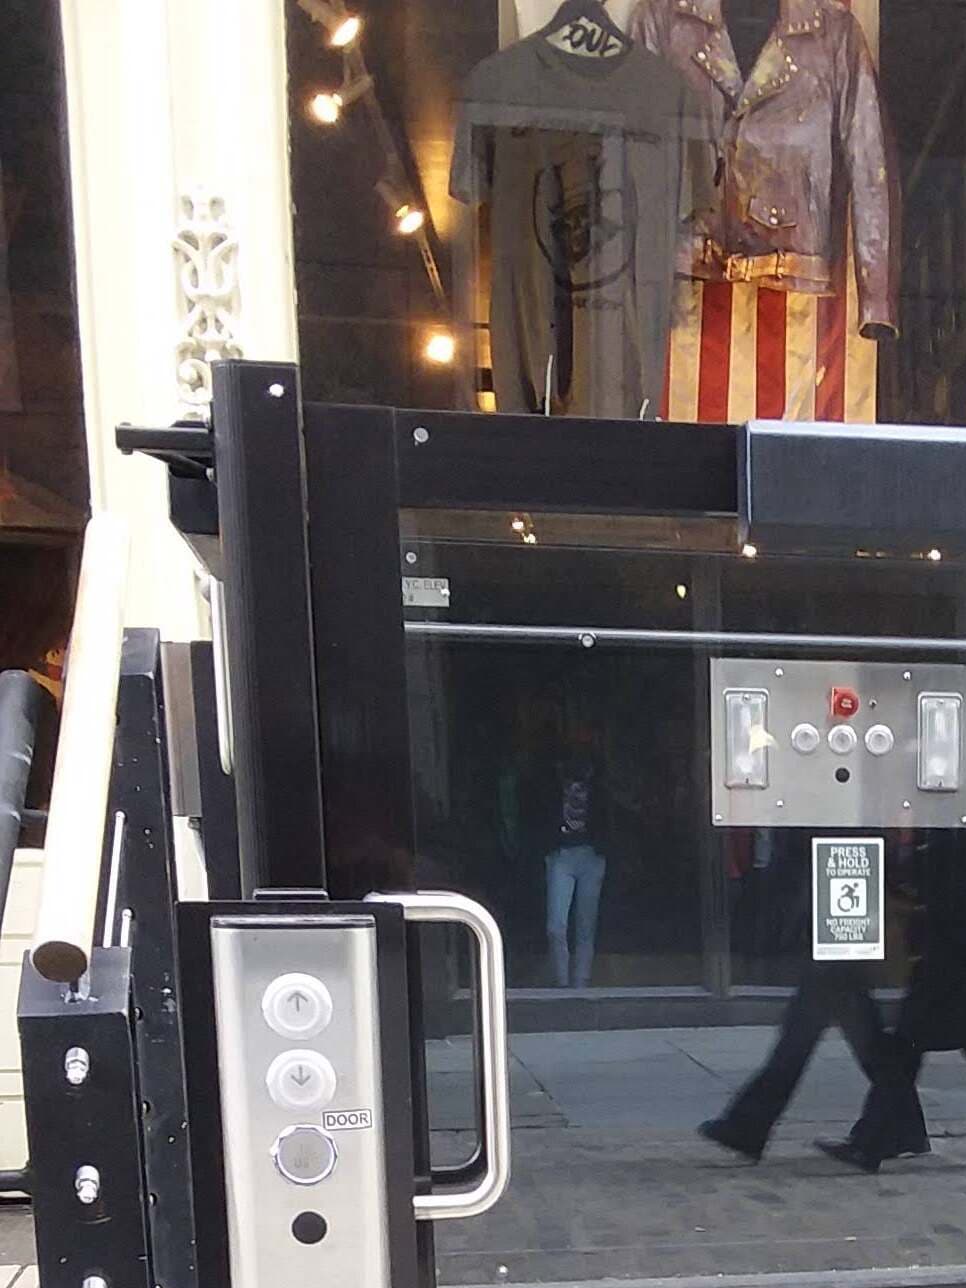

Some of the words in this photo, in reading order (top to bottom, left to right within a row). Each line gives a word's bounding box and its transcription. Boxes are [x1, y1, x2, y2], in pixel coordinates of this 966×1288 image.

[830, 846, 867, 858] PRESS
[827, 857, 836, 868] &
[838, 857, 870, 868] HOLD
[825, 868, 836, 877] TO
[837, 868, 871, 877] OPERATE
[826, 918, 838, 927] NO
[326, 1112, 369, 1127] DOOR
